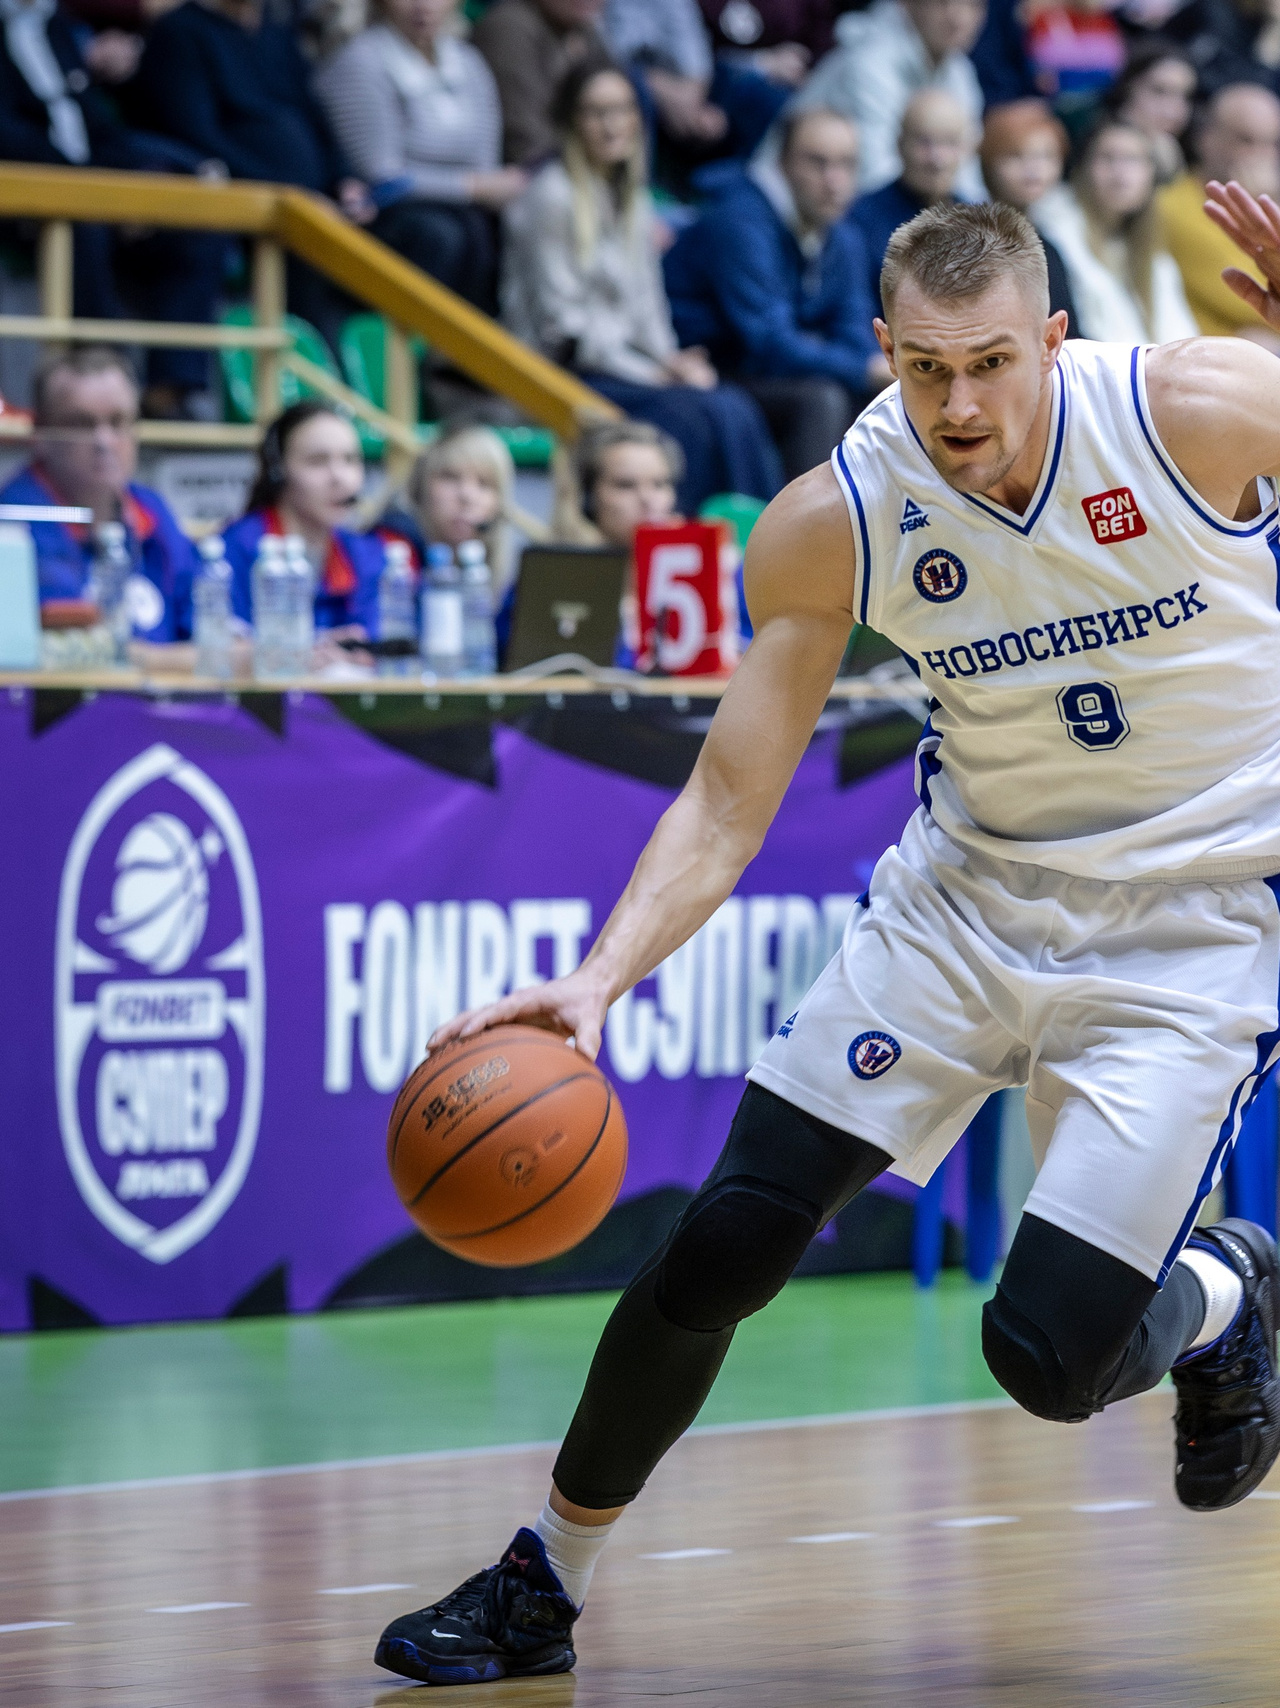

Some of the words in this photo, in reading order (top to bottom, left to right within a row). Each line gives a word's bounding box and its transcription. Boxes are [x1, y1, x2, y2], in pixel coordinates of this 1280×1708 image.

[899, 514, 931, 535] PEAK
[1089, 493, 1132, 520] FON
[1096, 511, 1137, 538] BET
[646, 542, 708, 672] 5
[921, 582, 1208, 679] НОВОСИБИРСК
[1055, 681, 1131, 752] 9
